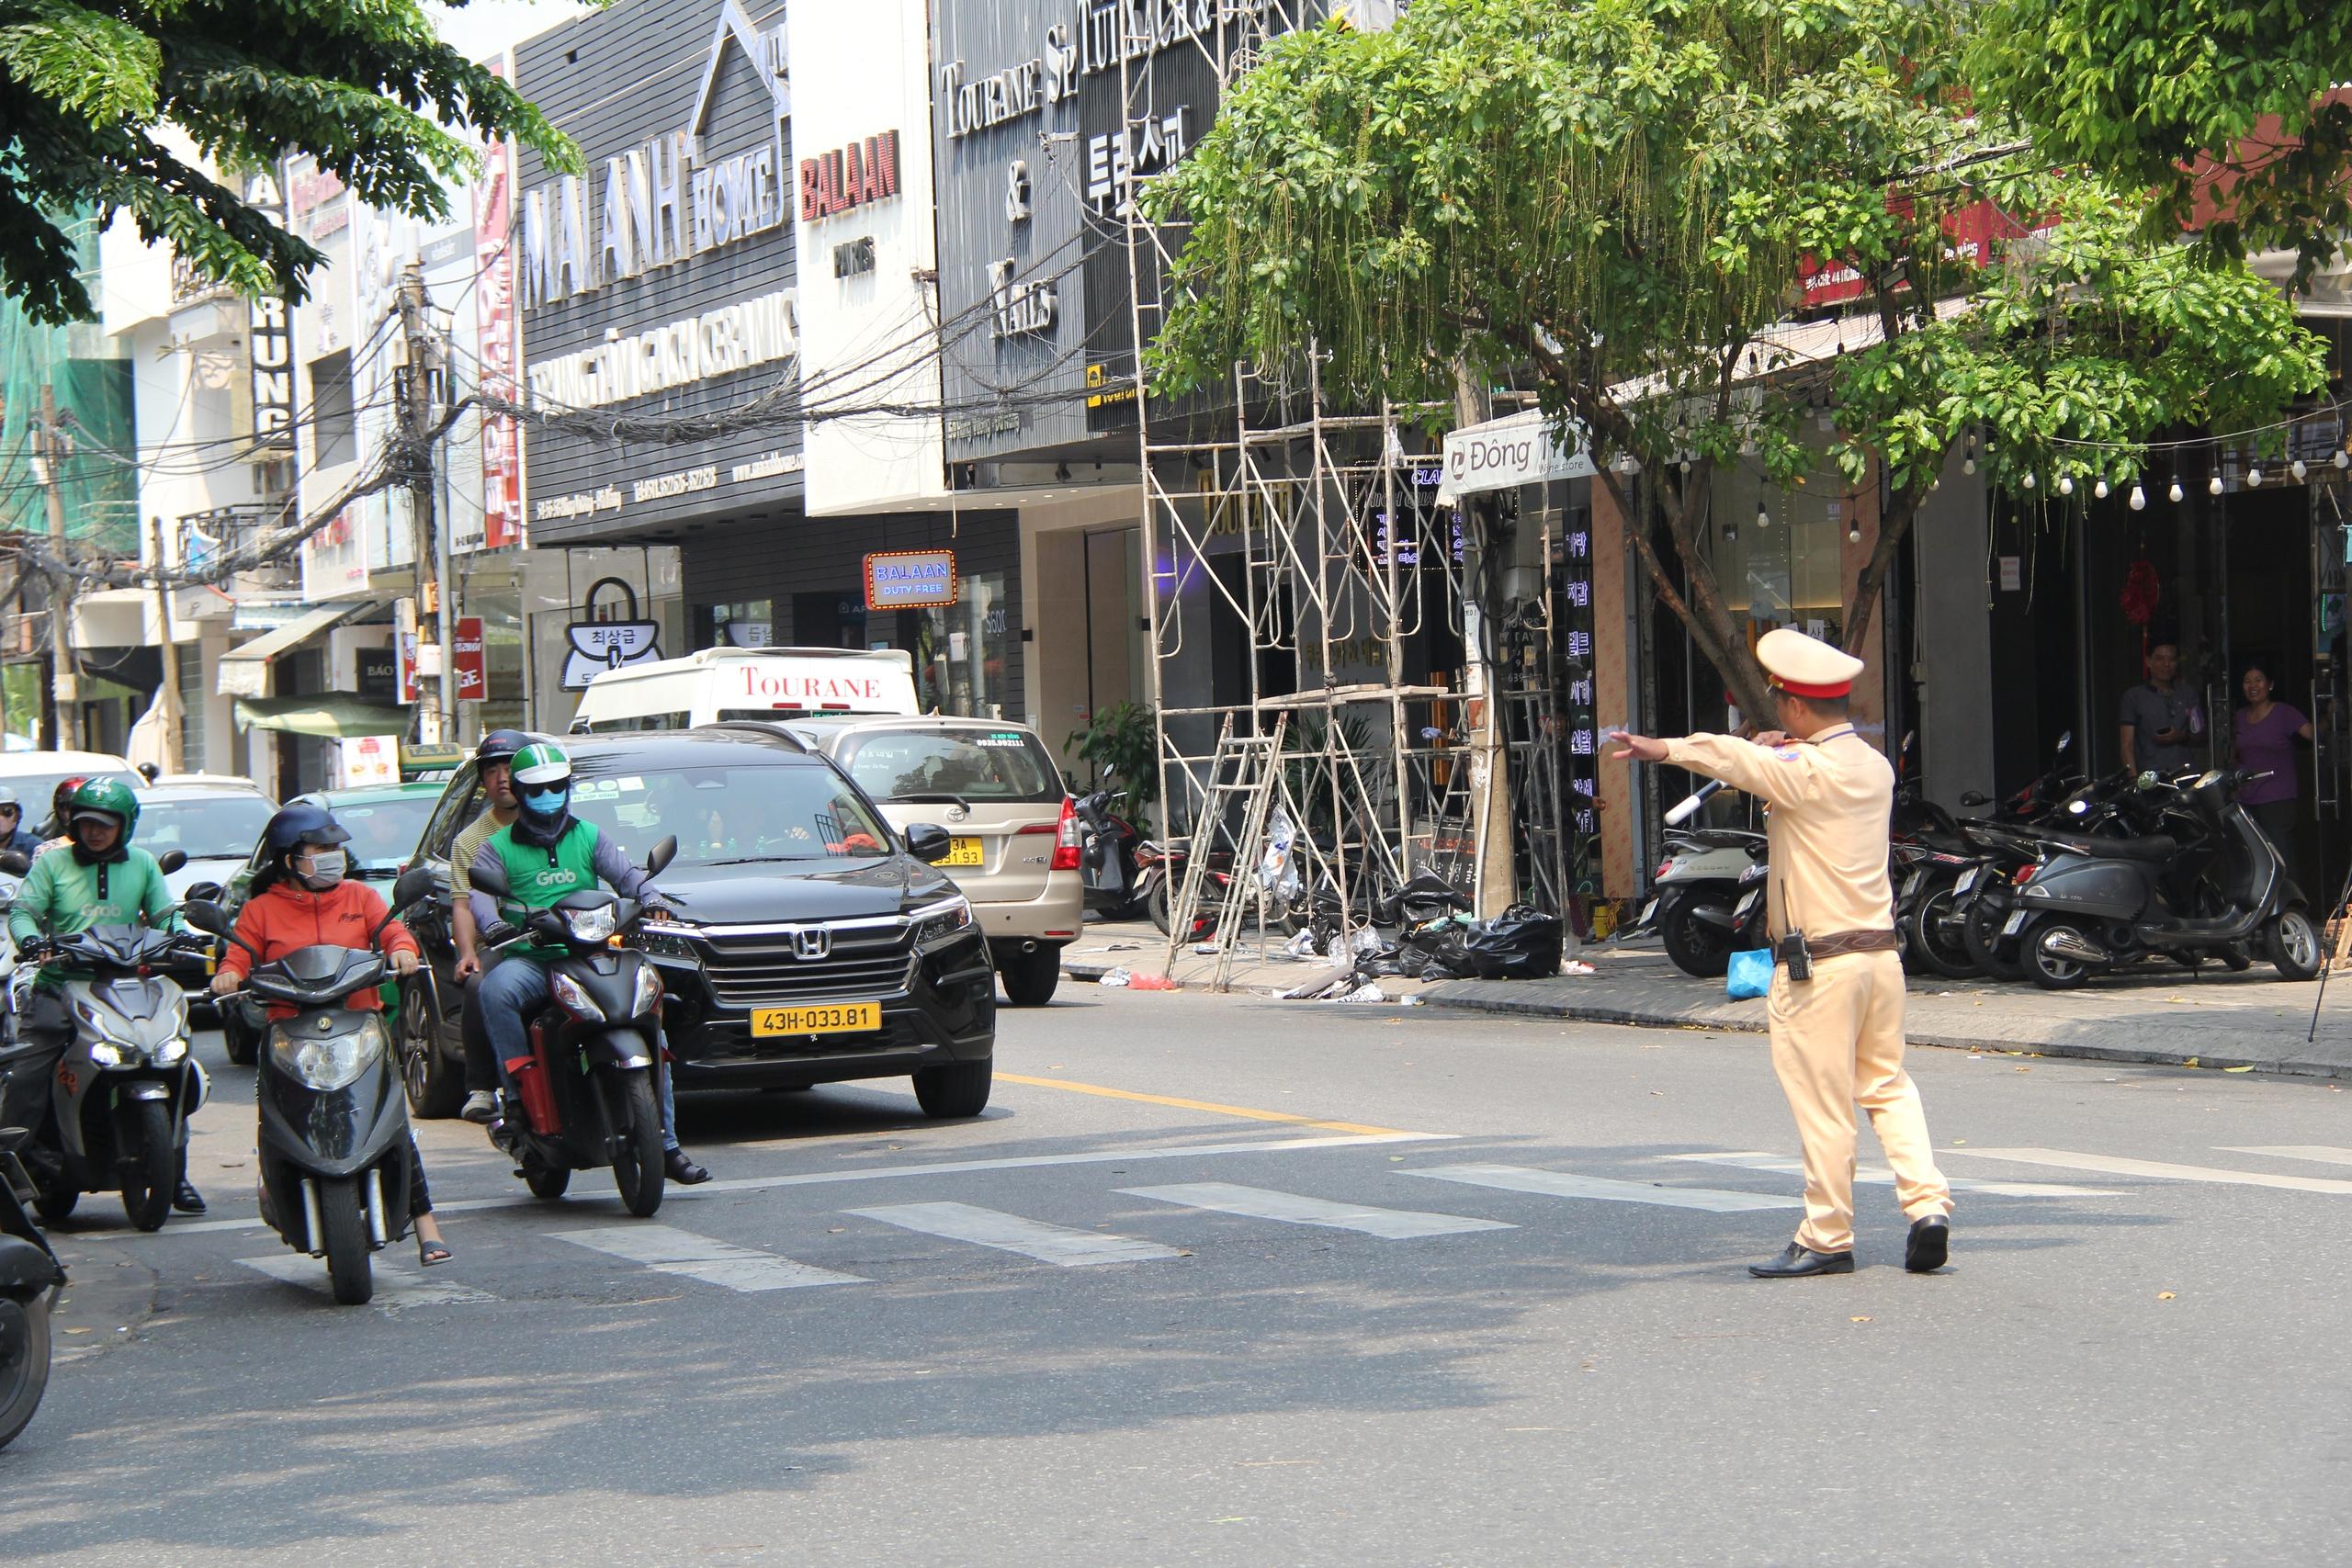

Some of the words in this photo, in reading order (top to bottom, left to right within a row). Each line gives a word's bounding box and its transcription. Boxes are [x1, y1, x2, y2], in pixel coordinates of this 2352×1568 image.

[941, 58, 1043, 139] TOURANE
[1046, 23, 1079, 103] SP
[800, 130, 900, 221] BALAAN
[1005, 160, 1032, 222] &
[524, 169, 599, 310] MAI
[602, 131, 689, 286] ANH
[834, 235, 876, 278] PARIS
[986, 257, 1058, 339] NAILS
[528, 348, 597, 417] TRUNG
[594, 327, 641, 402] TÂM
[1470, 440, 1531, 472] Đông
[1538, 463, 1559, 475] Wne
[1561, 459, 1584, 471] store
[1411, 469, 1444, 485] CLA
[1198, 468, 1294, 536] TOUA
[876, 562, 948, 581] BALAAN
[883, 584, 912, 595] DUTY
[915, 583, 943, 594] FREE
[1566, 581, 1589, 607] 지갑
[592, 629, 637, 646] 최상급
[1567, 630, 1589, 657] 벨트
[580, 672, 596, 685] 도
[740, 666, 881, 699] TOURANE
[1569, 678, 1591, 706] 시계
[1571, 728, 1593, 755] 신발
[87, 783, 112, 794] Grab
[937, 852, 978, 864] 1.93
[952, 839, 967, 851] 3A
[537, 867, 577, 886] Grab
[81, 903, 121, 918] Grab
[763, 1008, 868, 1031] 43H-033.81
